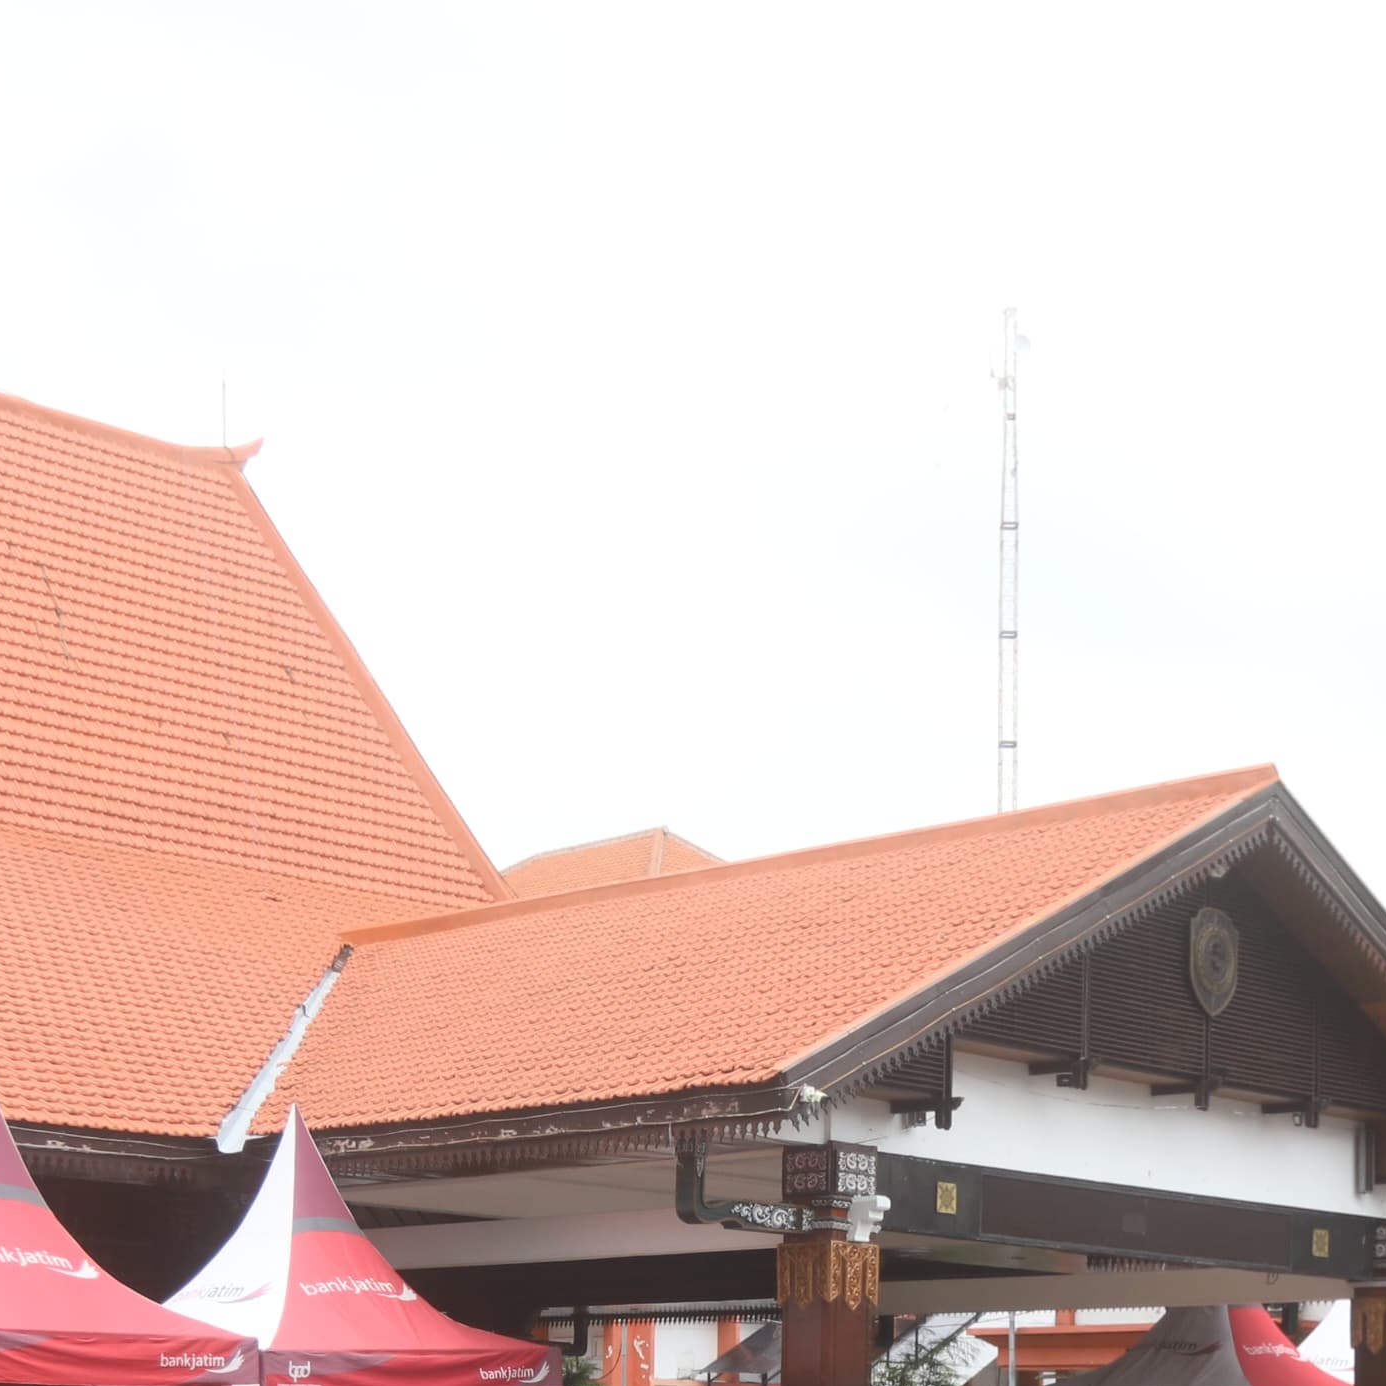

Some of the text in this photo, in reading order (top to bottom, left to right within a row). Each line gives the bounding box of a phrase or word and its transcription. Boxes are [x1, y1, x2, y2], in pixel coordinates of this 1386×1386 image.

[299, 1276, 397, 1296] bankjatim
[160, 1351, 226, 1370] bankjatim
[479, 1365, 535, 1381] bankjatim
